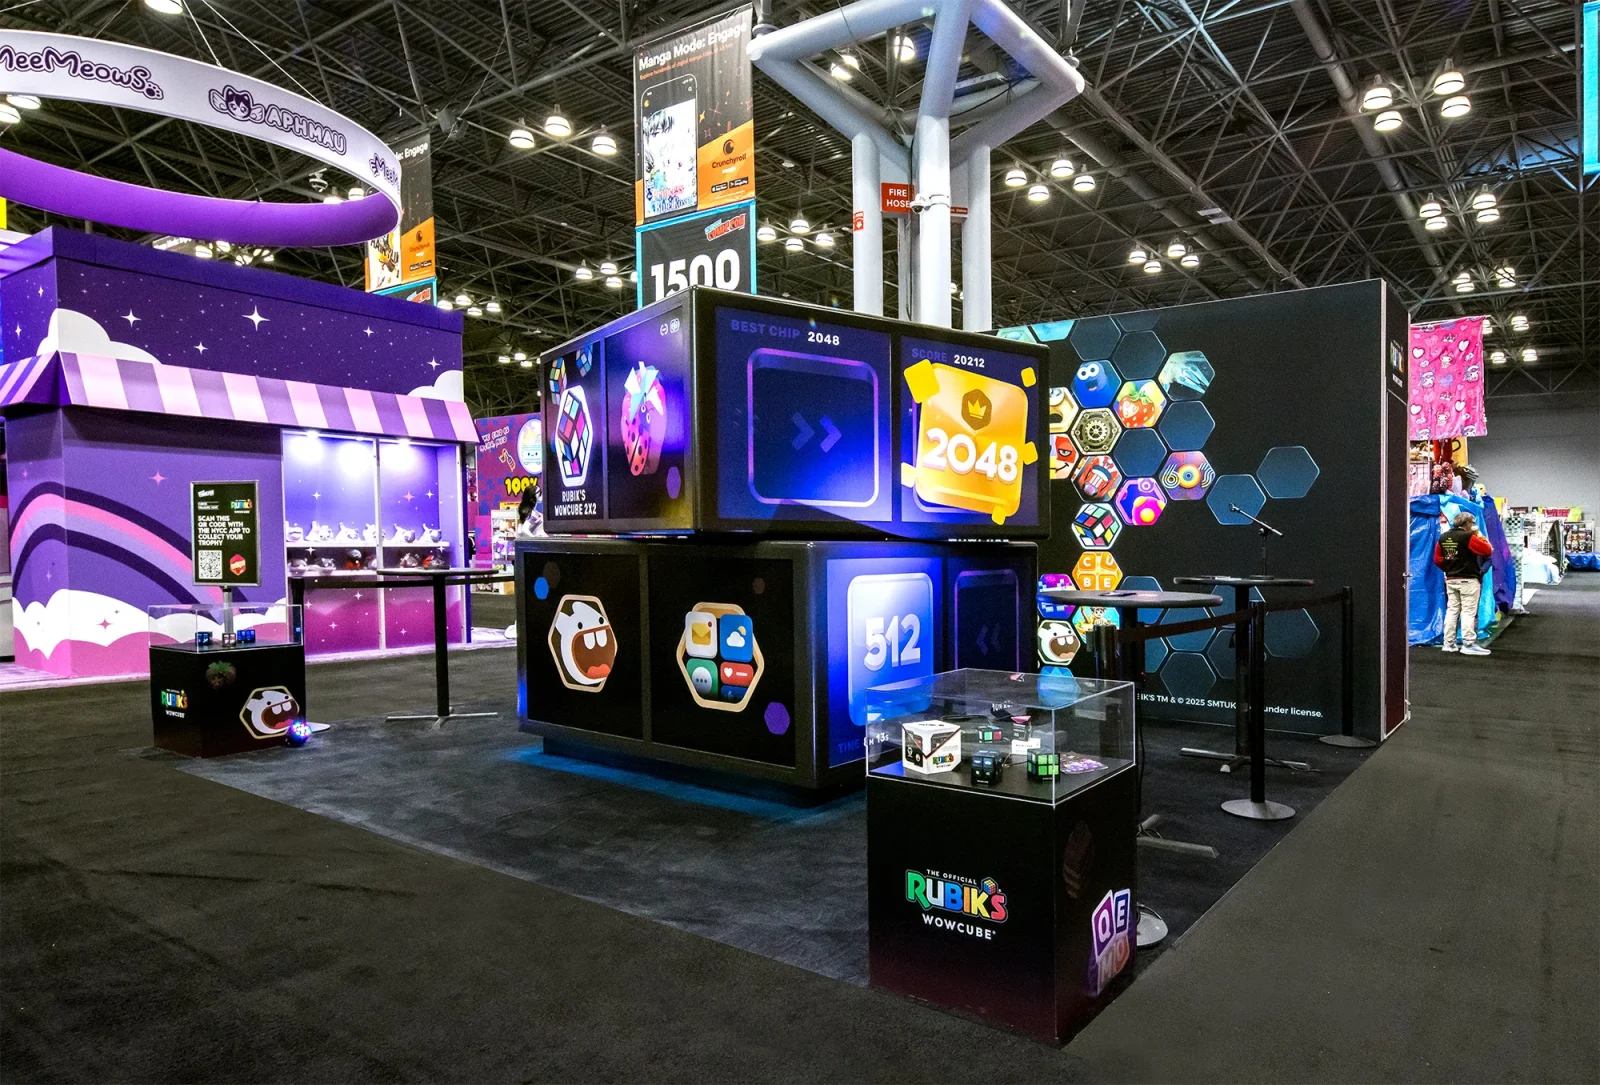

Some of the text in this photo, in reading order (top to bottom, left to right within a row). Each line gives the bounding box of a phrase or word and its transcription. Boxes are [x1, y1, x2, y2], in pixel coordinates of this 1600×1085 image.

[639, 50, 672, 71] Manga
[673, 39, 706, 58] Mode:
[708, 22, 748, 46] Engage
[267, 106, 346, 154] APHMAU
[404, 142, 429, 158] Engage
[712, 153, 747, 169] Crunchyroll
[888, 188, 907, 197] FIRE
[886, 199, 910, 208] HOSE
[651, 248, 740, 302] 1500
[731, 319, 840, 346] BEST CHIP 2048
[911, 348, 985, 368] SCORE 20212
[922, 427, 1018, 484] 2048
[562, 489, 586, 502] RUBIK'S
[554, 503, 597, 517] WOWCUBE 2X2
[864, 613, 921, 671] 512
[1139, 693, 1155, 703] IK'S
[1156, 694, 1169, 704] TM
[1170, 695, 1177, 704] &
[1185, 697, 1206, 708] 2025
[1290, 707, 1324, 718] license.
[838, 740, 860, 753] TIME
[926, 869, 977, 885] THE OFFICIAL
